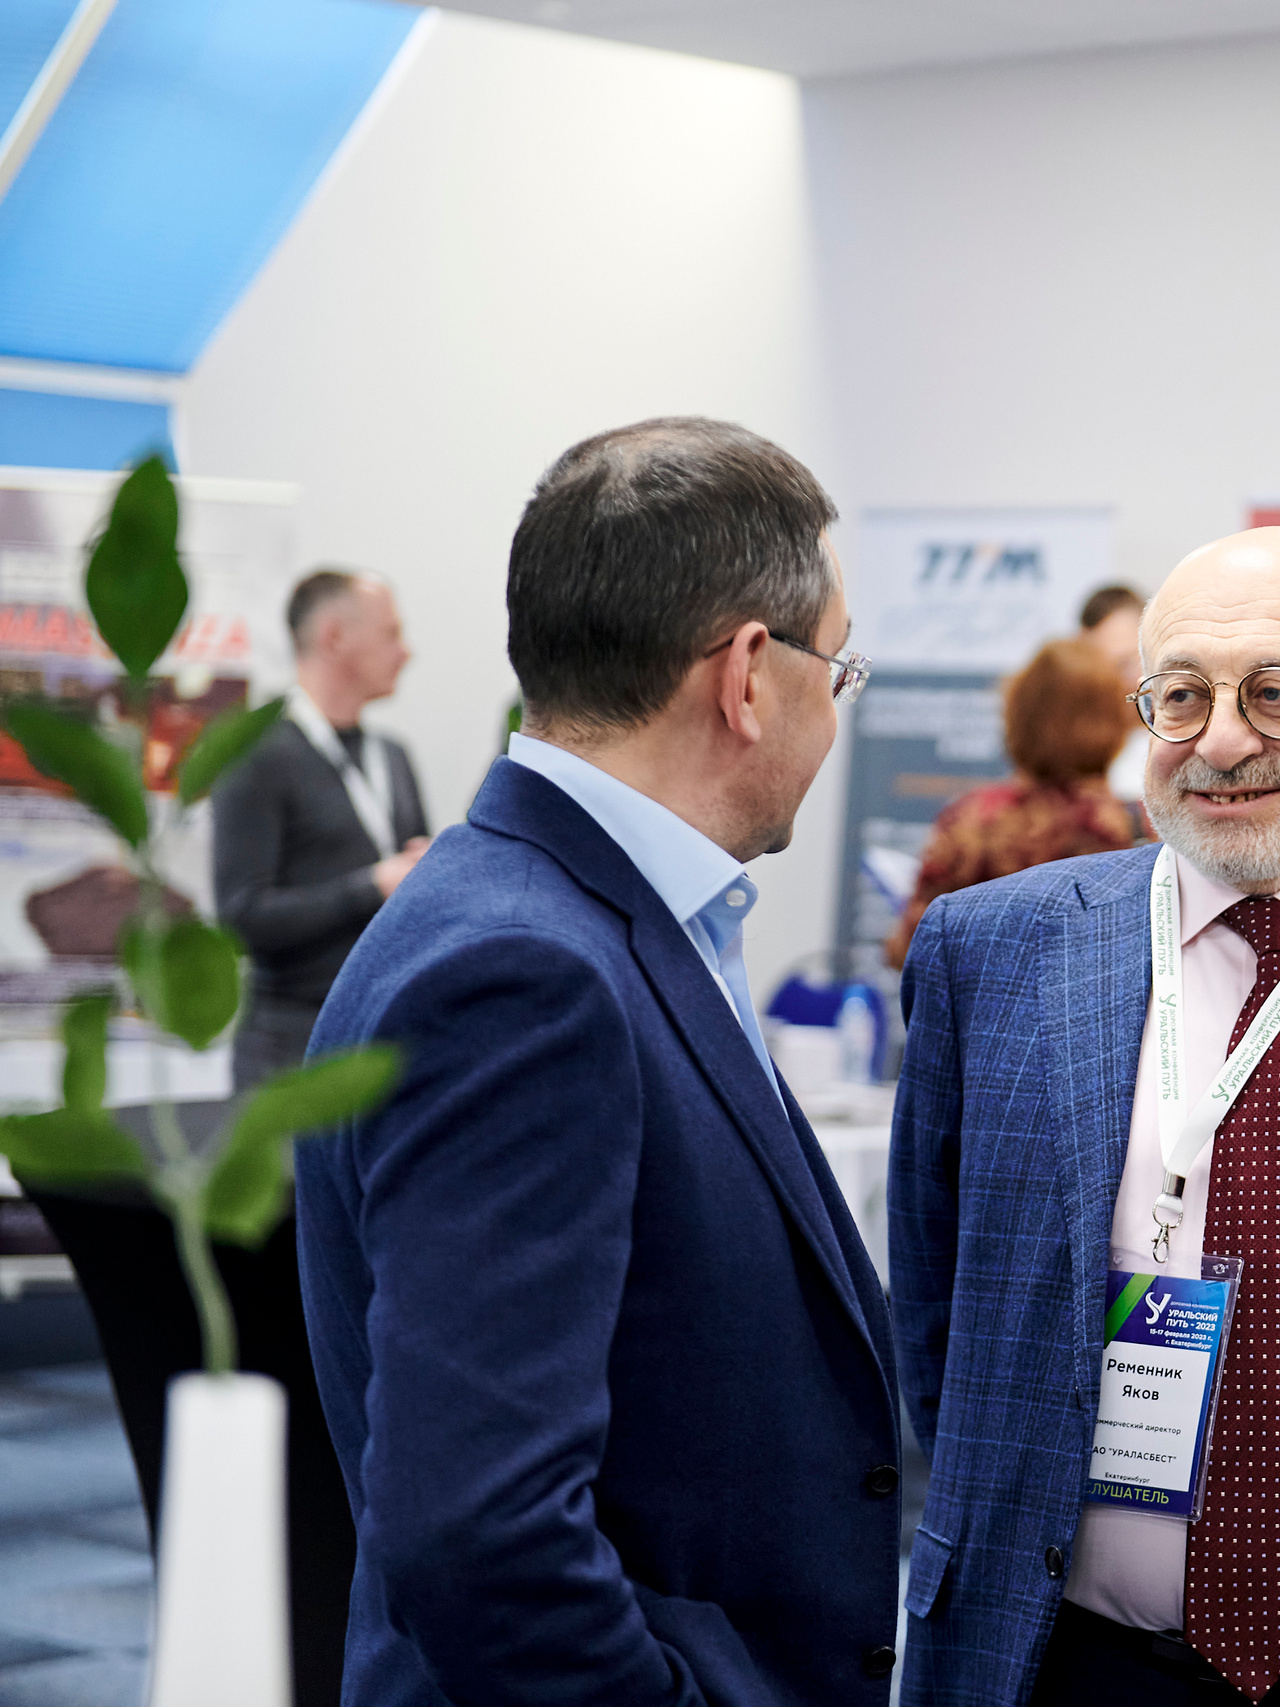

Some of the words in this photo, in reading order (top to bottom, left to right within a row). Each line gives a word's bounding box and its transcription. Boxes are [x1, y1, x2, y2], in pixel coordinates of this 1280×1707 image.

[1156, 891, 1166, 946] УРАЛЬСКИЙ
[1158, 948, 1166, 976] ПУТЬ
[1159, 1008, 1171, 1069] УРАЛЬСКИЙ
[1229, 1030, 1272, 1089] УРАЛЬСКИЙ
[1161, 1071, 1171, 1100] ПУТЬ
[1168, 1309, 1218, 1322] УРАЛЬСКИЙ
[1166, 1318, 1189, 1328] ПУТЬ
[1195, 1322, 1216, 1331] 2023
[1164, 1330, 1190, 1338] февраля
[1171, 1340, 1212, 1350] Екатеринбург
[1106, 1358, 1183, 1380] Ременник
[1122, 1384, 1160, 1401] Яков
[1095, 1418, 1143, 1430] оммерческий
[1145, 1425, 1181, 1435] директор
[1092, 1445, 1106, 1455] АО
[1108, 1447, 1177, 1463] "УРАЛАСБЕСТ"
[1105, 1472, 1151, 1484] Екатеринбург
